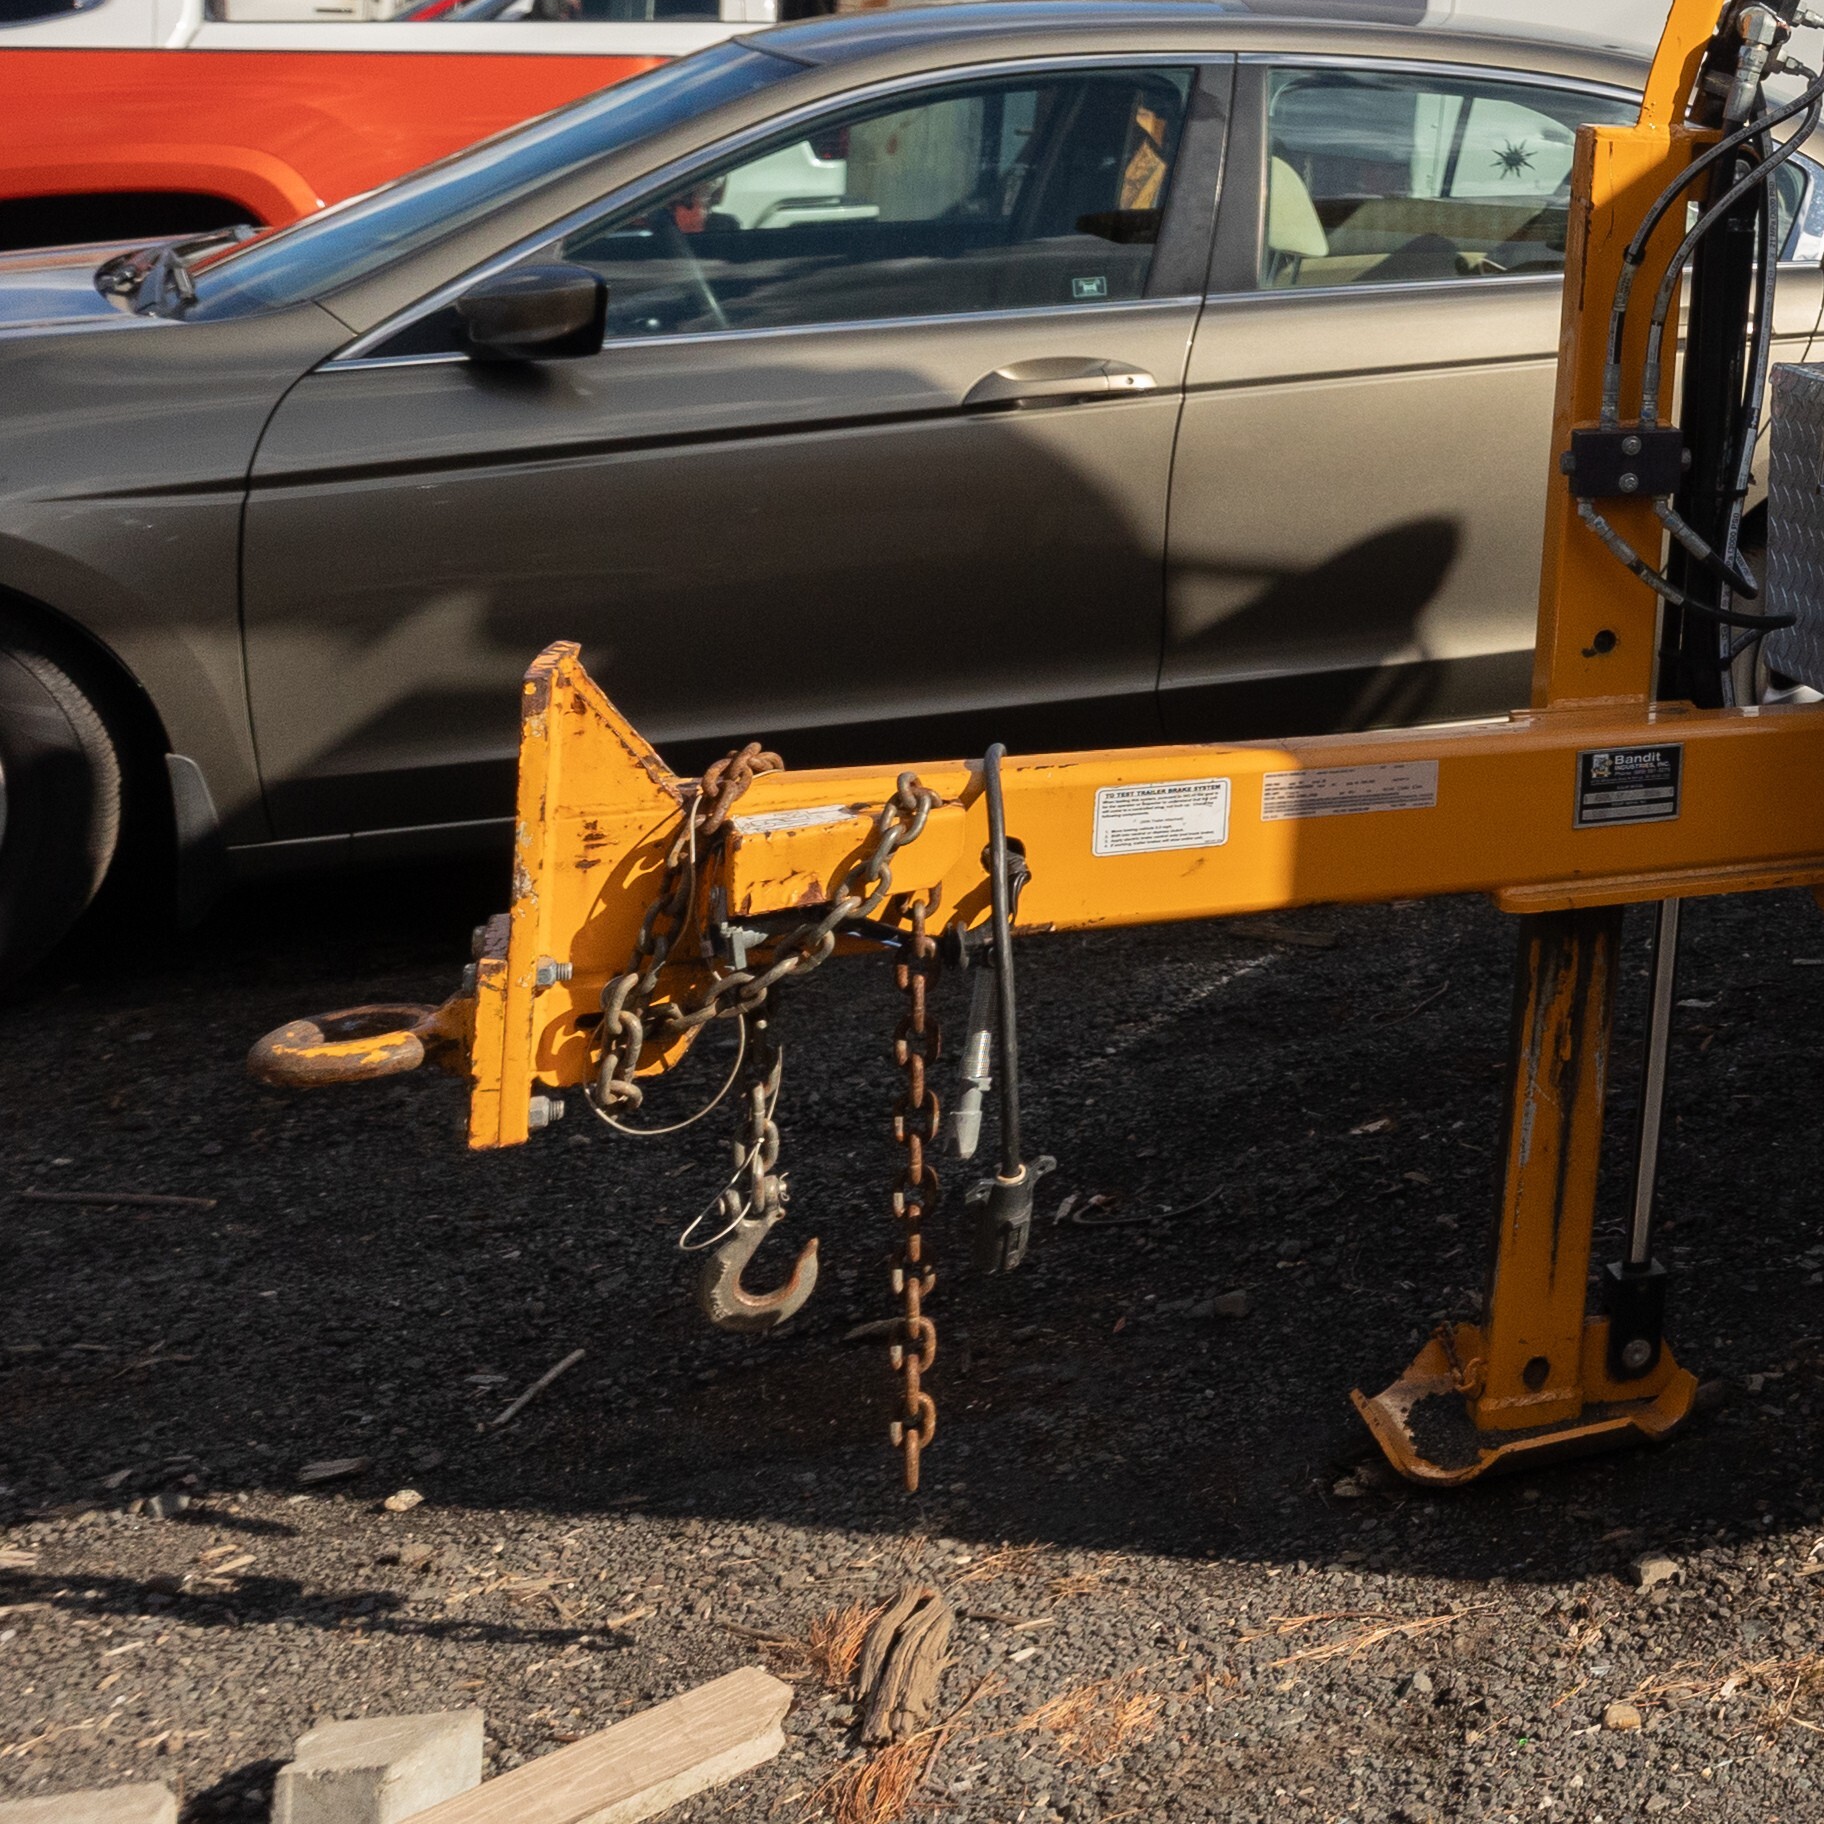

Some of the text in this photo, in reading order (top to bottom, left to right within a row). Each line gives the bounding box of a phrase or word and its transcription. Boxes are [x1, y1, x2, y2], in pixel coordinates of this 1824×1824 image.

[1615, 752, 1661, 765] Bandit
[1137, 788, 1167, 796] TRAILER
[1168, 786, 1192, 794] BRAKE
[1194, 784, 1221, 792] SYSTEM
